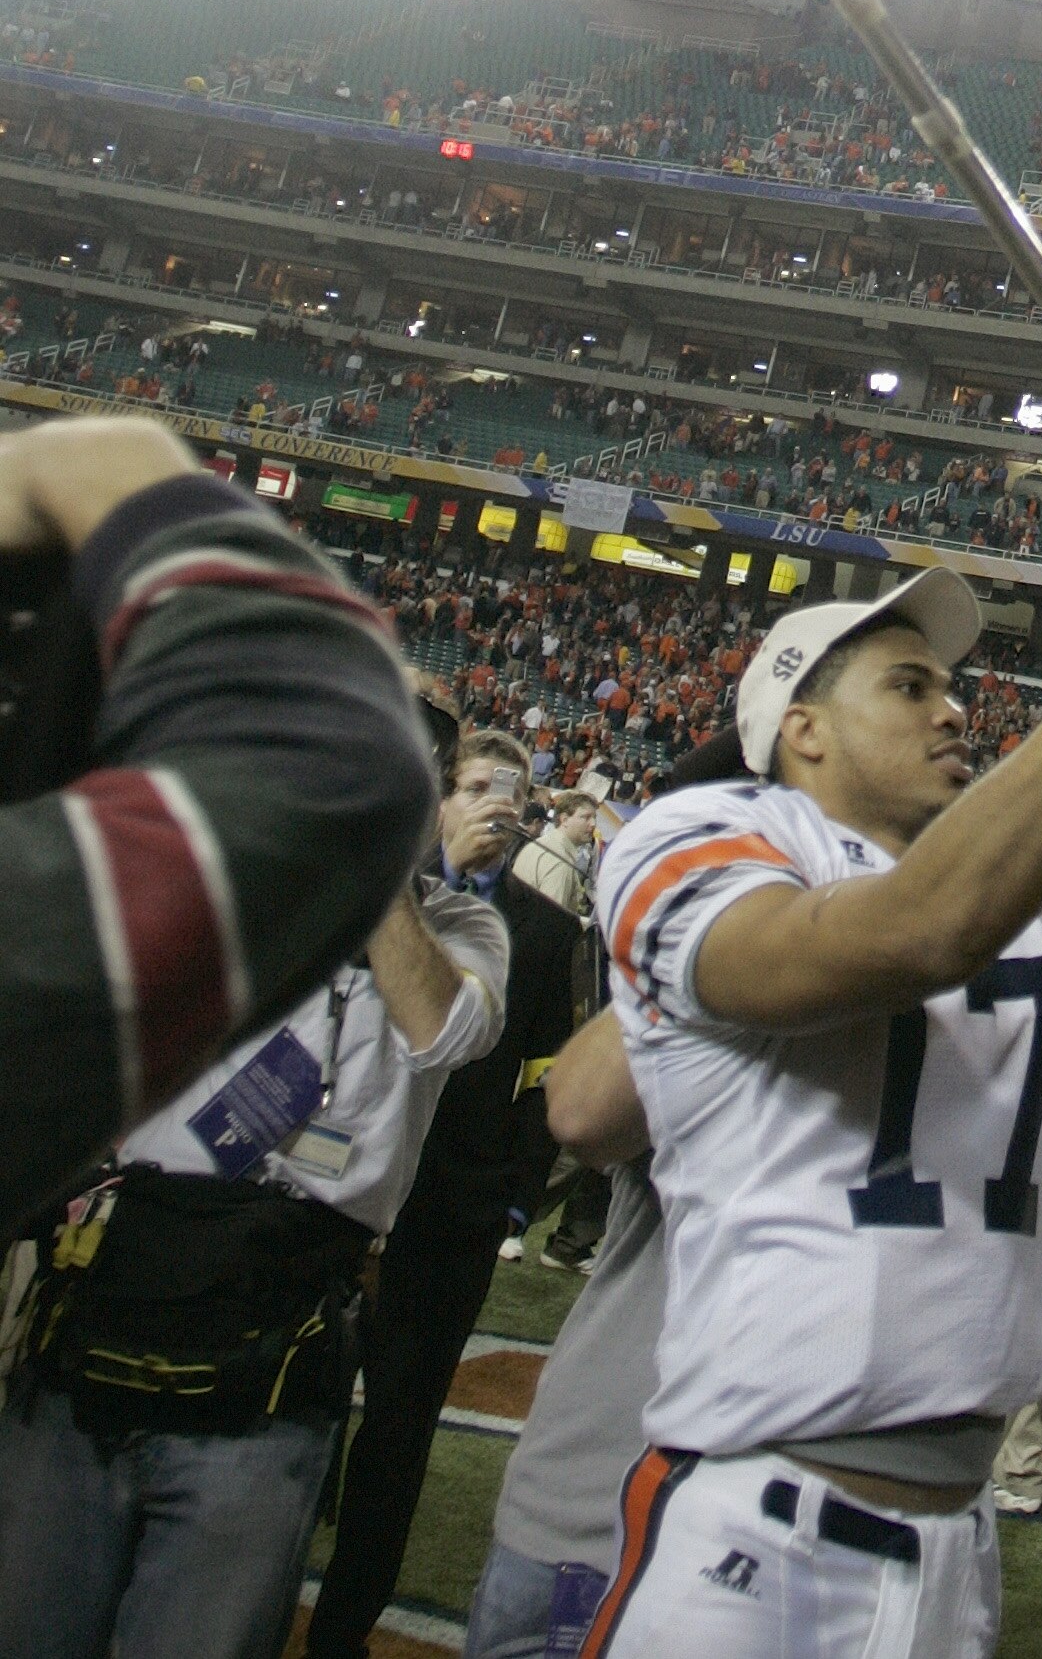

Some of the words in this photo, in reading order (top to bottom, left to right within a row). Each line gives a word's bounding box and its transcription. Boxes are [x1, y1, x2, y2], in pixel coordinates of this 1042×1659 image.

[219, 426, 252, 443] SEC
[259, 432, 399, 472] CONFERENCE
[770, 521, 827, 547] LSU
[772, 646, 804, 682] SEC
[213, 1128, 238, 1148] P
